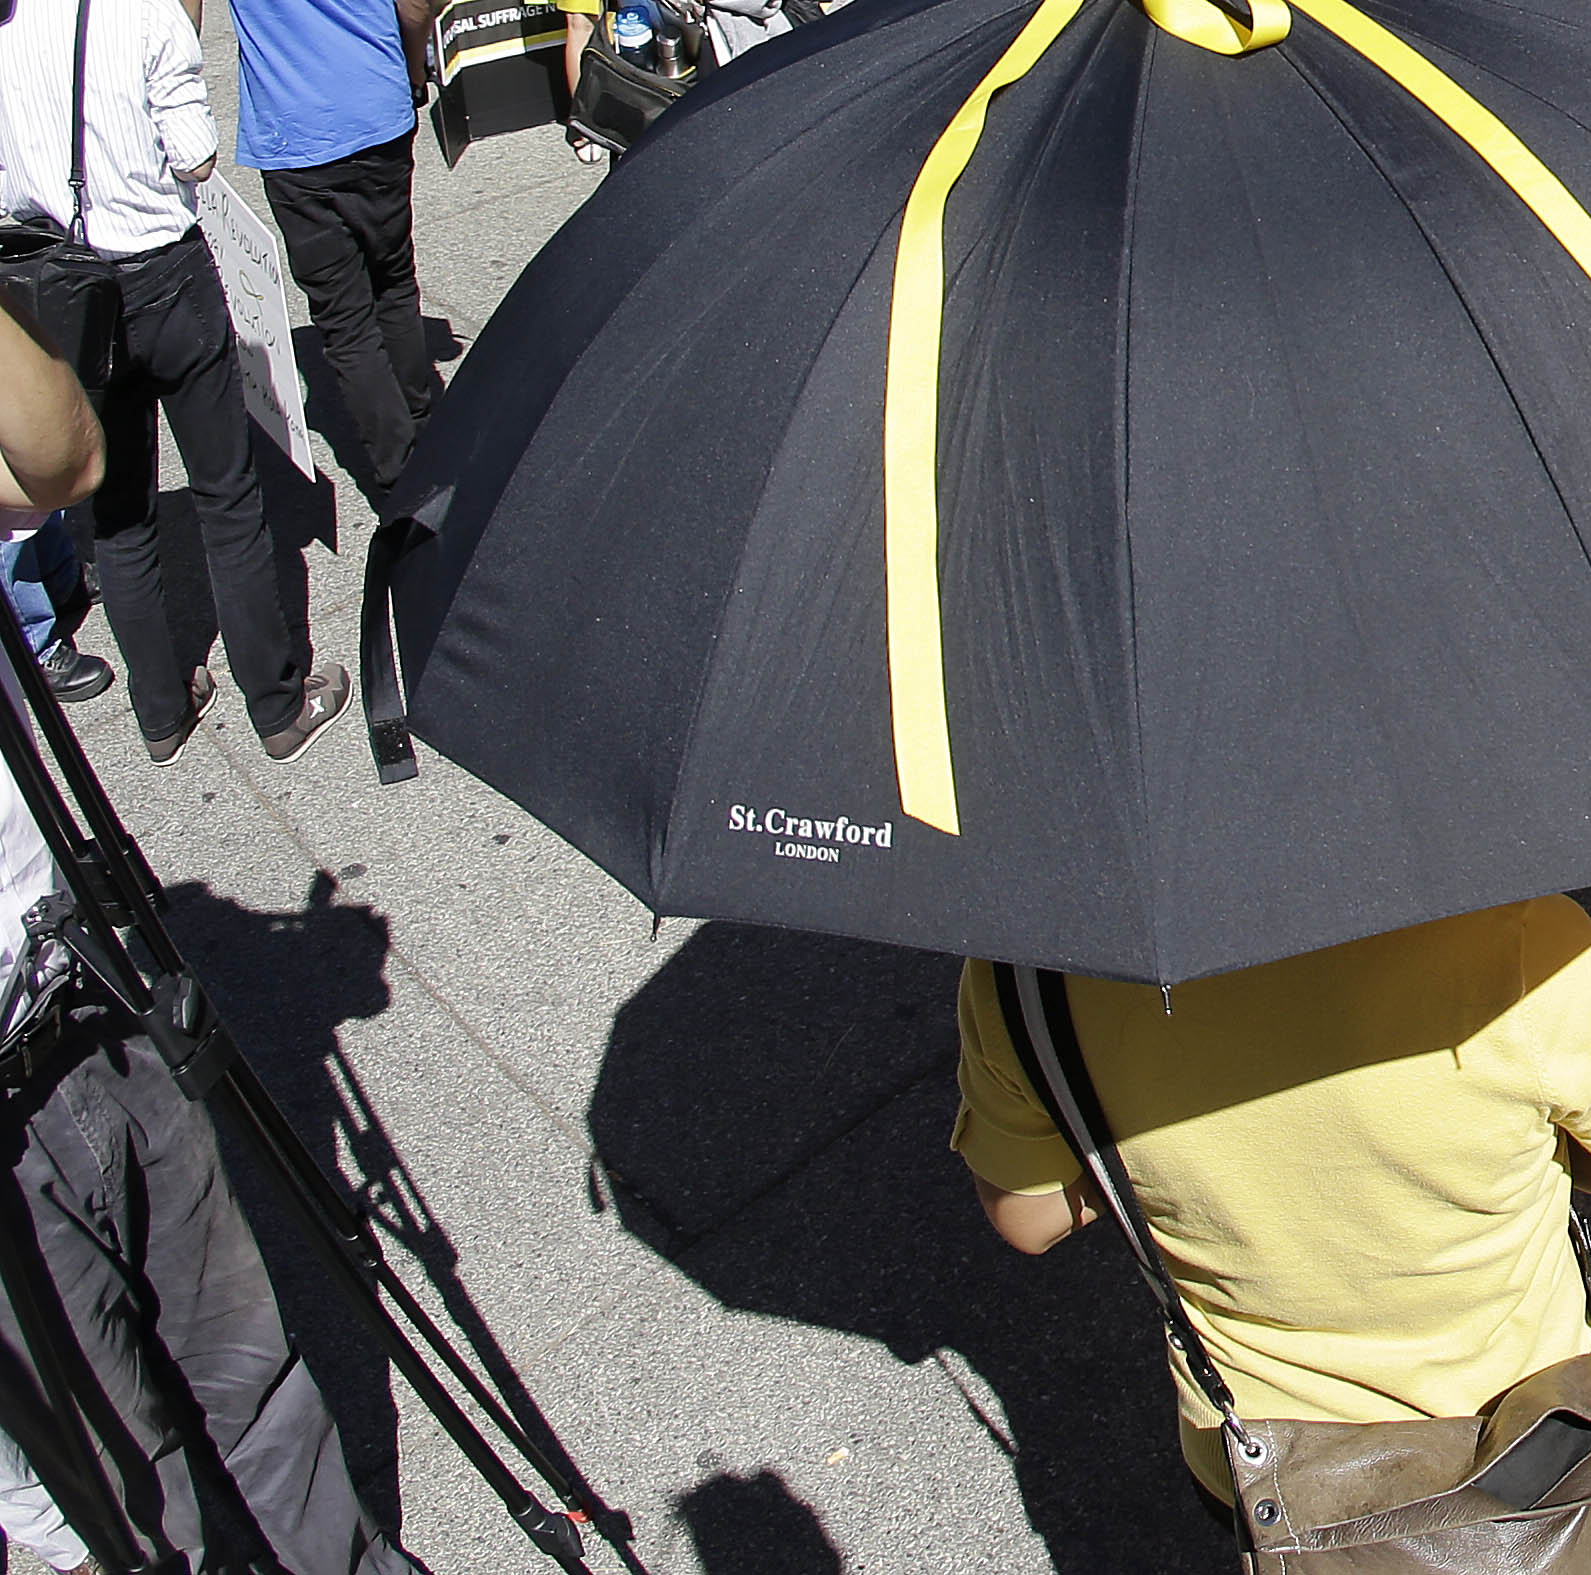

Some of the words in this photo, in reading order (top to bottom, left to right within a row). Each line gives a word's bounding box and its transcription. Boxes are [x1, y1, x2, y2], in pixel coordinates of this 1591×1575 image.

[477, 4, 544, 30] SUFFRAGE
[728, 804, 893, 849] St.Crawford
[775, 842, 840, 863] LONDON
